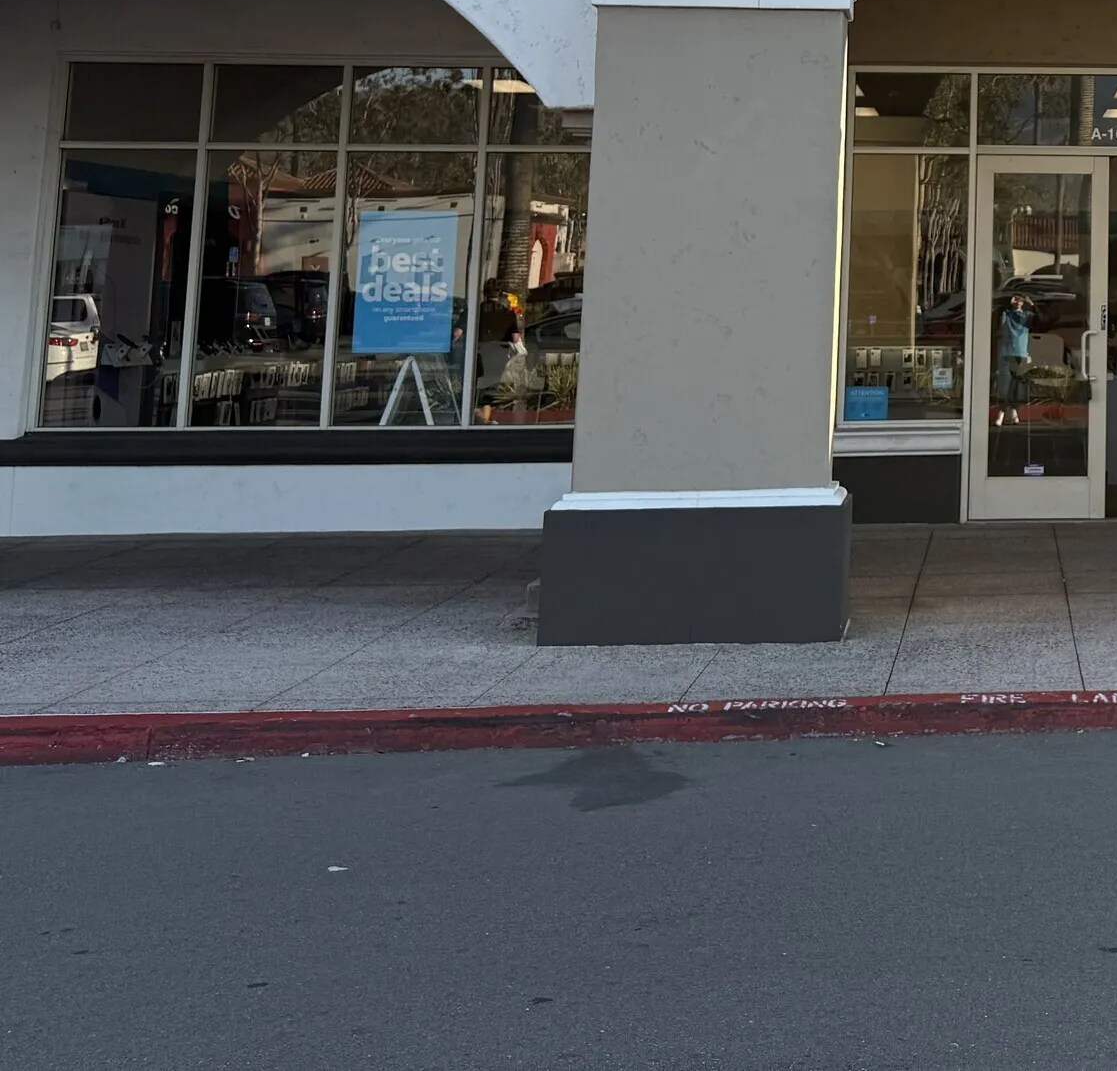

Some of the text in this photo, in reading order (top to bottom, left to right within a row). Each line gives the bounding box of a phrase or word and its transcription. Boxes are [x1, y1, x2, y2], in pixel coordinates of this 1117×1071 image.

[368, 244, 445, 274] best
[362, 274, 449, 303] deals
[383, 315, 424, 323] guaranteed
[668, 703, 708, 713] NO
[724, 699, 847, 711] PARKING
[961, 693, 1027, 704] FIRE
